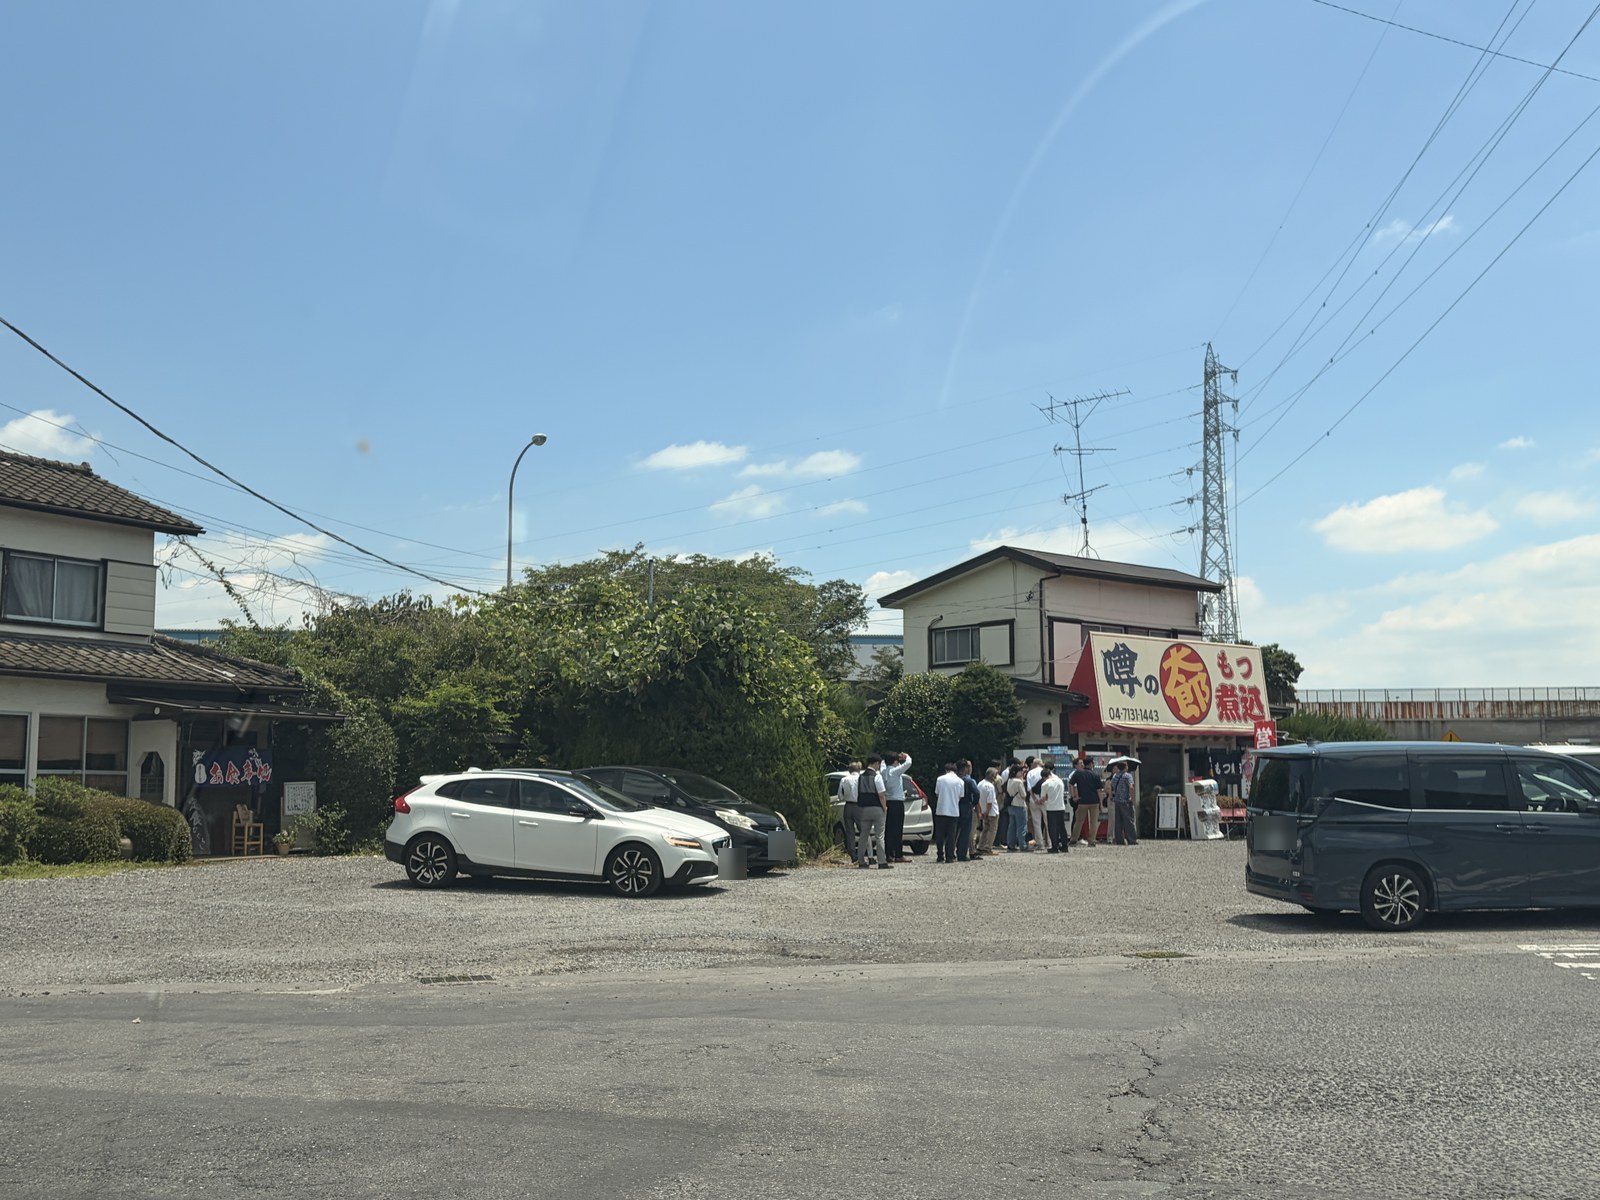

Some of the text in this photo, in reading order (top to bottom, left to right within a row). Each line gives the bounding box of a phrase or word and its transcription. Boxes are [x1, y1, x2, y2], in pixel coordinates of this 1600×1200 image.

[1217, 649, 1253, 680] もつ
[1108, 706, 1160, 722] 04-7131-1443
[1215, 682, 1266, 723] 煮込
